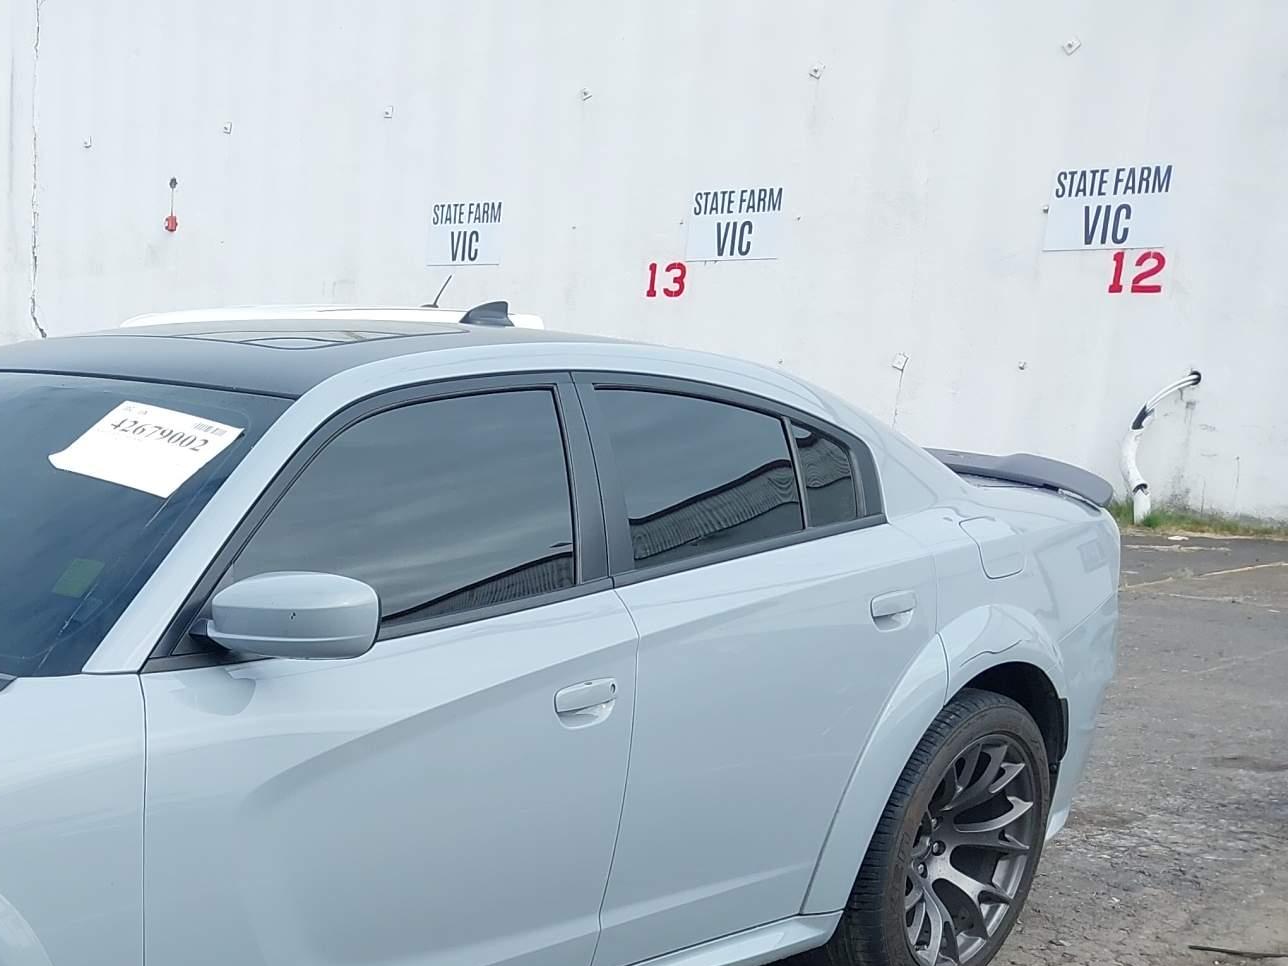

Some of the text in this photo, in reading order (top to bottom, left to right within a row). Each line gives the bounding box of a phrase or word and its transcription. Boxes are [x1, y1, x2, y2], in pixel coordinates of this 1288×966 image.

[1055, 165, 1173, 198] STATE FARM
[432, 202, 502, 225] STATE FARM
[693, 187, 783, 216] STATE FARM
[716, 220, 753, 257] VIC
[1084, 203, 1132, 246] VIC
[450, 230, 479, 262] VIC
[646, 262, 687, 298] 13
[1108, 251, 1166, 293] 12
[110, 418, 210, 452] 42679002
